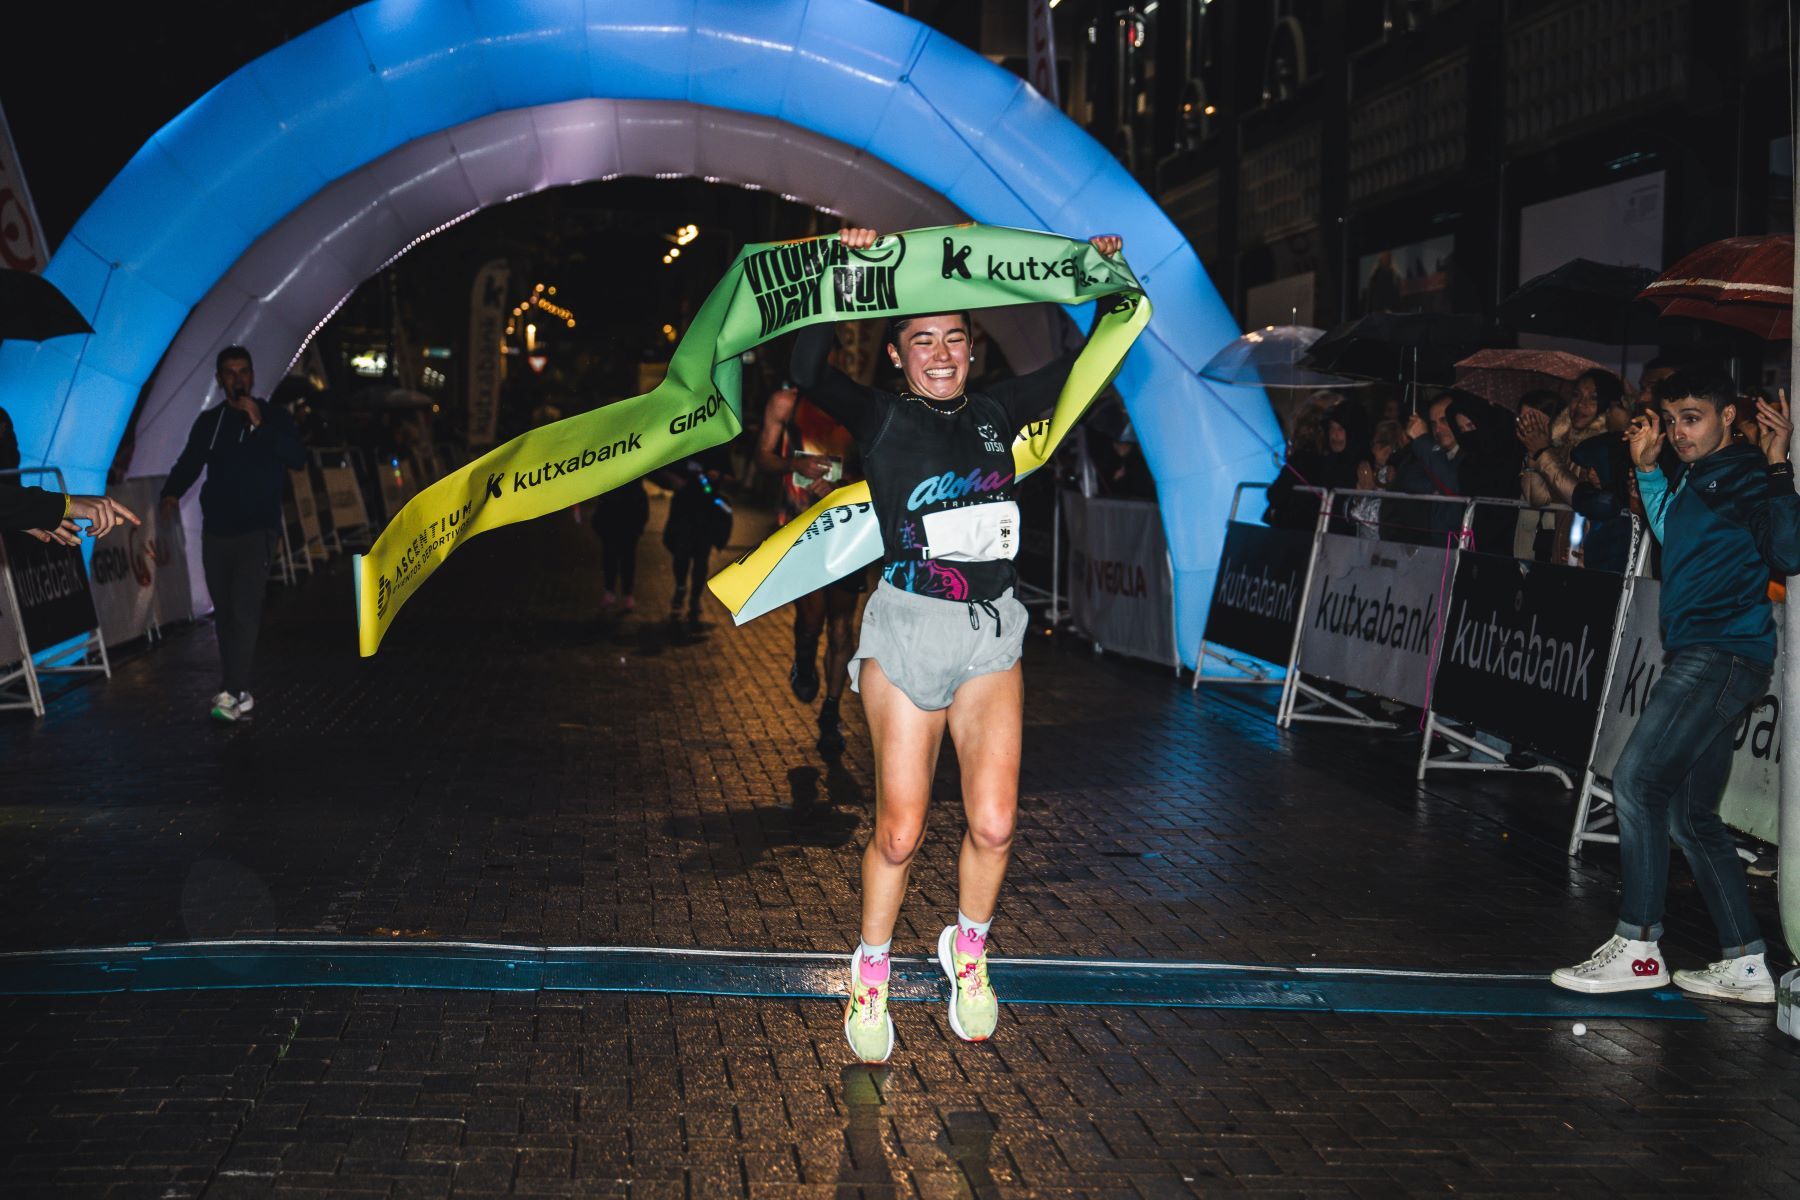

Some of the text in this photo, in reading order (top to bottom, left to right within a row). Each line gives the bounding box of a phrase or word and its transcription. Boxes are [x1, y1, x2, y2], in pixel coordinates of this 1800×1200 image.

[513, 432, 642, 492] kutxabank
[985, 442, 1005, 453] OTSO
[1219, 558, 1297, 623] kutxabank
[1314, 575, 1436, 656] kutxabank
[1450, 599, 1595, 701] kutxabank
